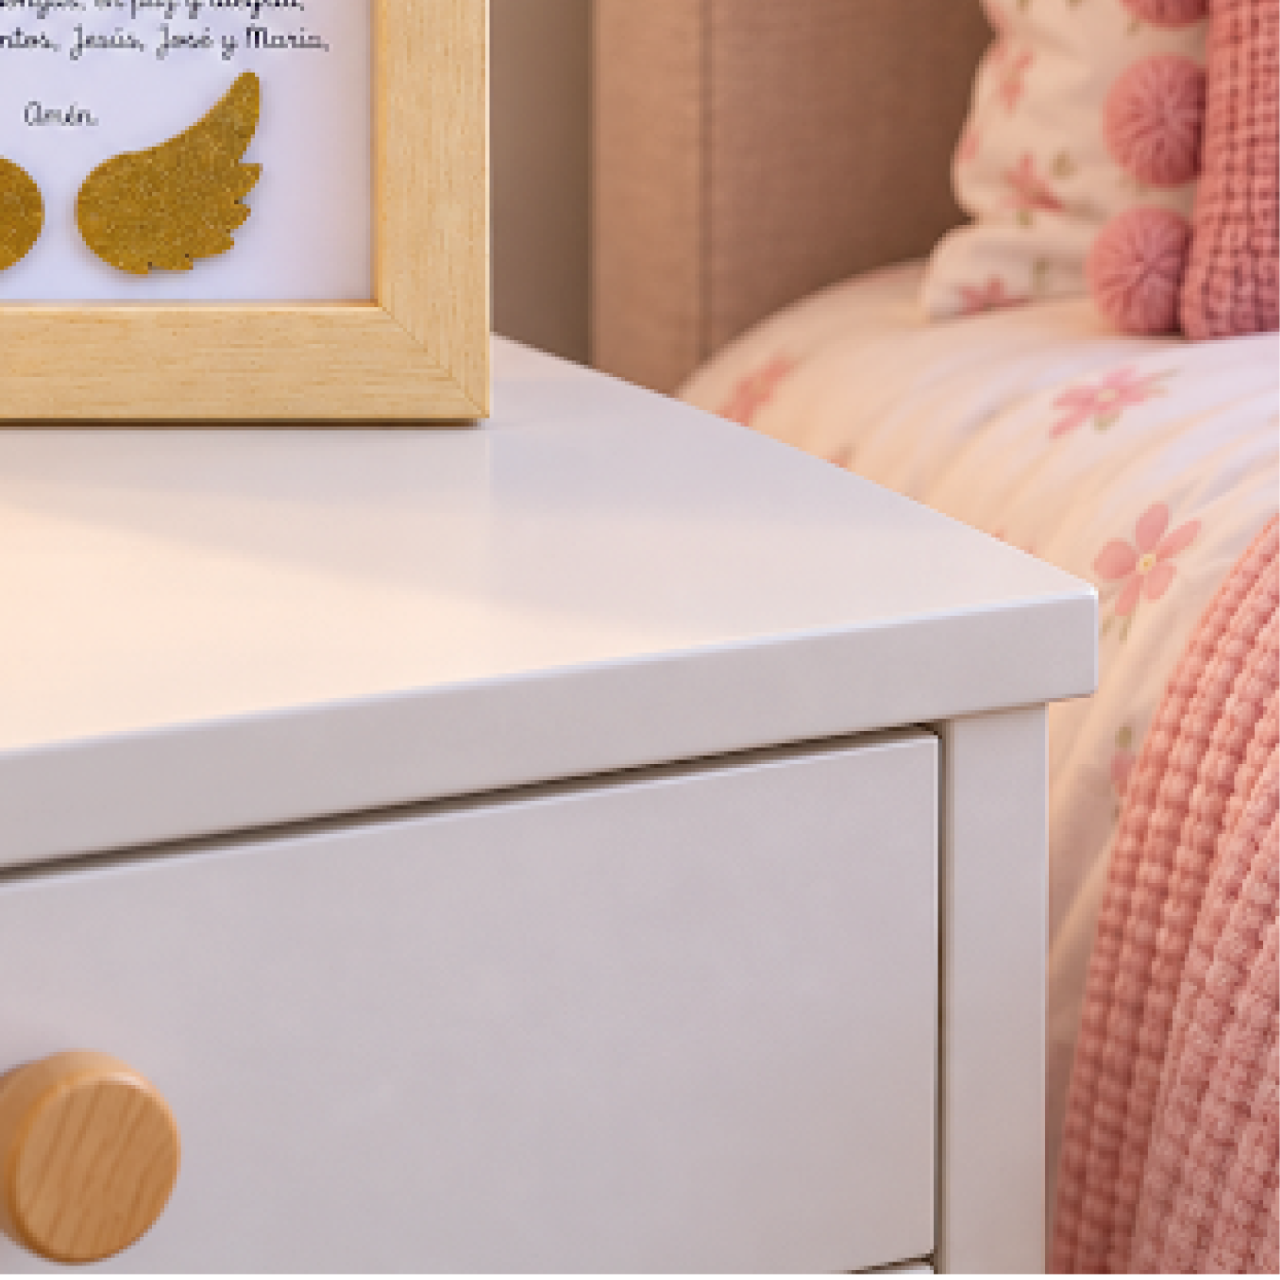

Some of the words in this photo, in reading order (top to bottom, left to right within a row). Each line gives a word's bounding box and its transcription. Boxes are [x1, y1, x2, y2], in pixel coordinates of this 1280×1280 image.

[69, 23, 145, 61] Jesús,
[155, 22, 215, 61] José
[221, 34, 239, 61] y
